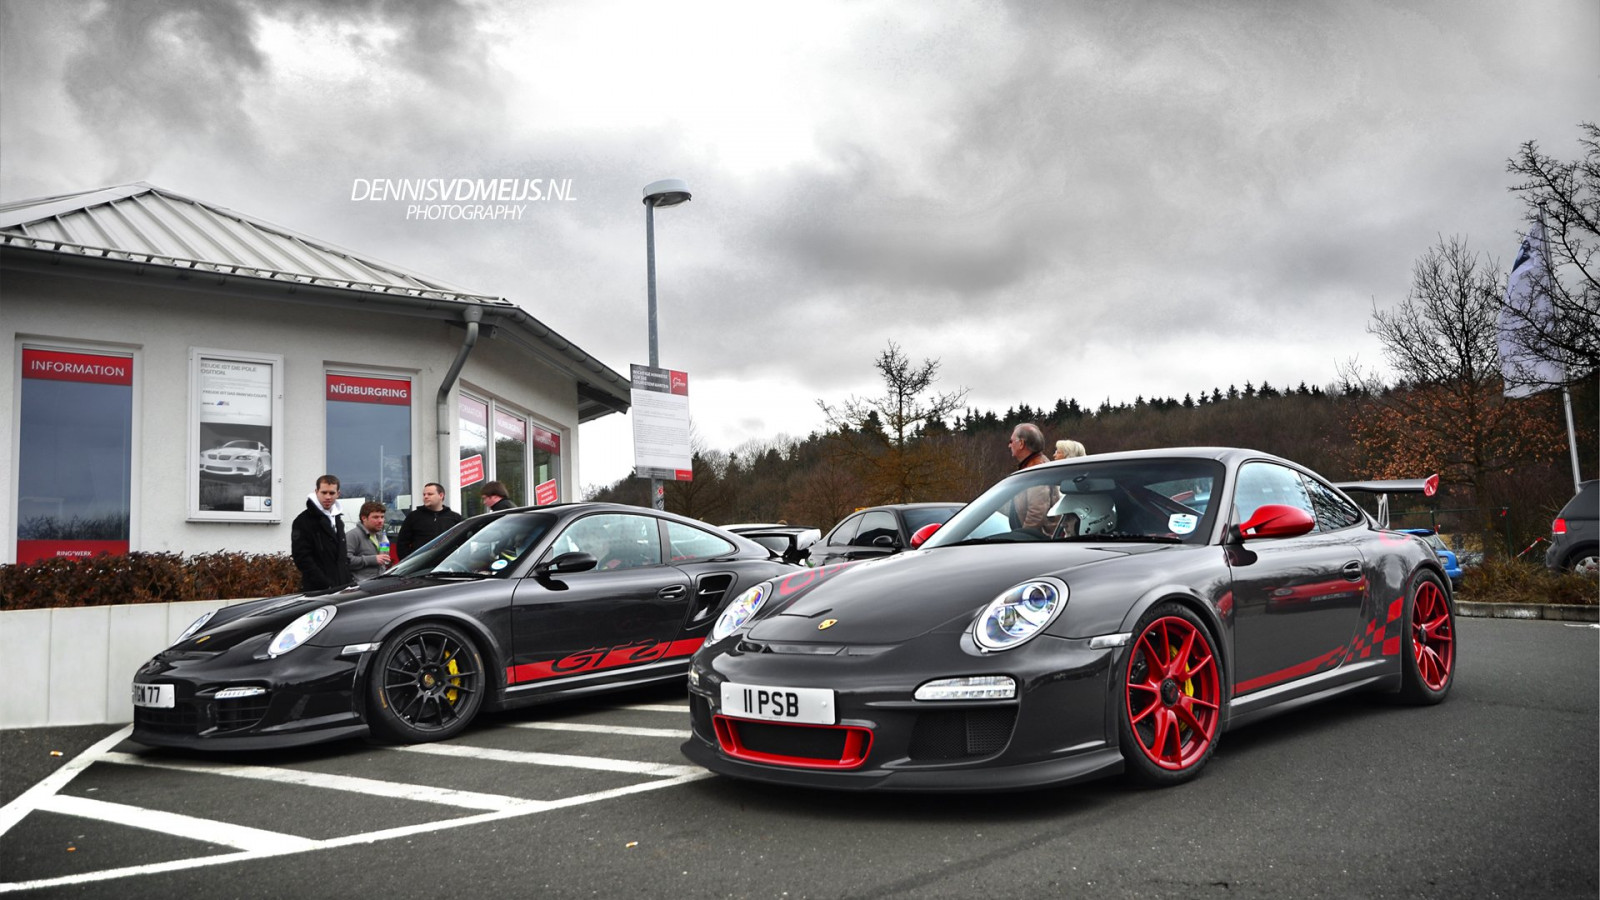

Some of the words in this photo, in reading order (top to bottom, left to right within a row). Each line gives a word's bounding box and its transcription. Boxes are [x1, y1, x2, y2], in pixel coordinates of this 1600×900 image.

[31, 360, 125, 377] INFORMATION
[330, 384, 408, 399] NÜRBURGRING
[147, 686, 161, 704] 77
[757, 690, 799, 718] PSB
